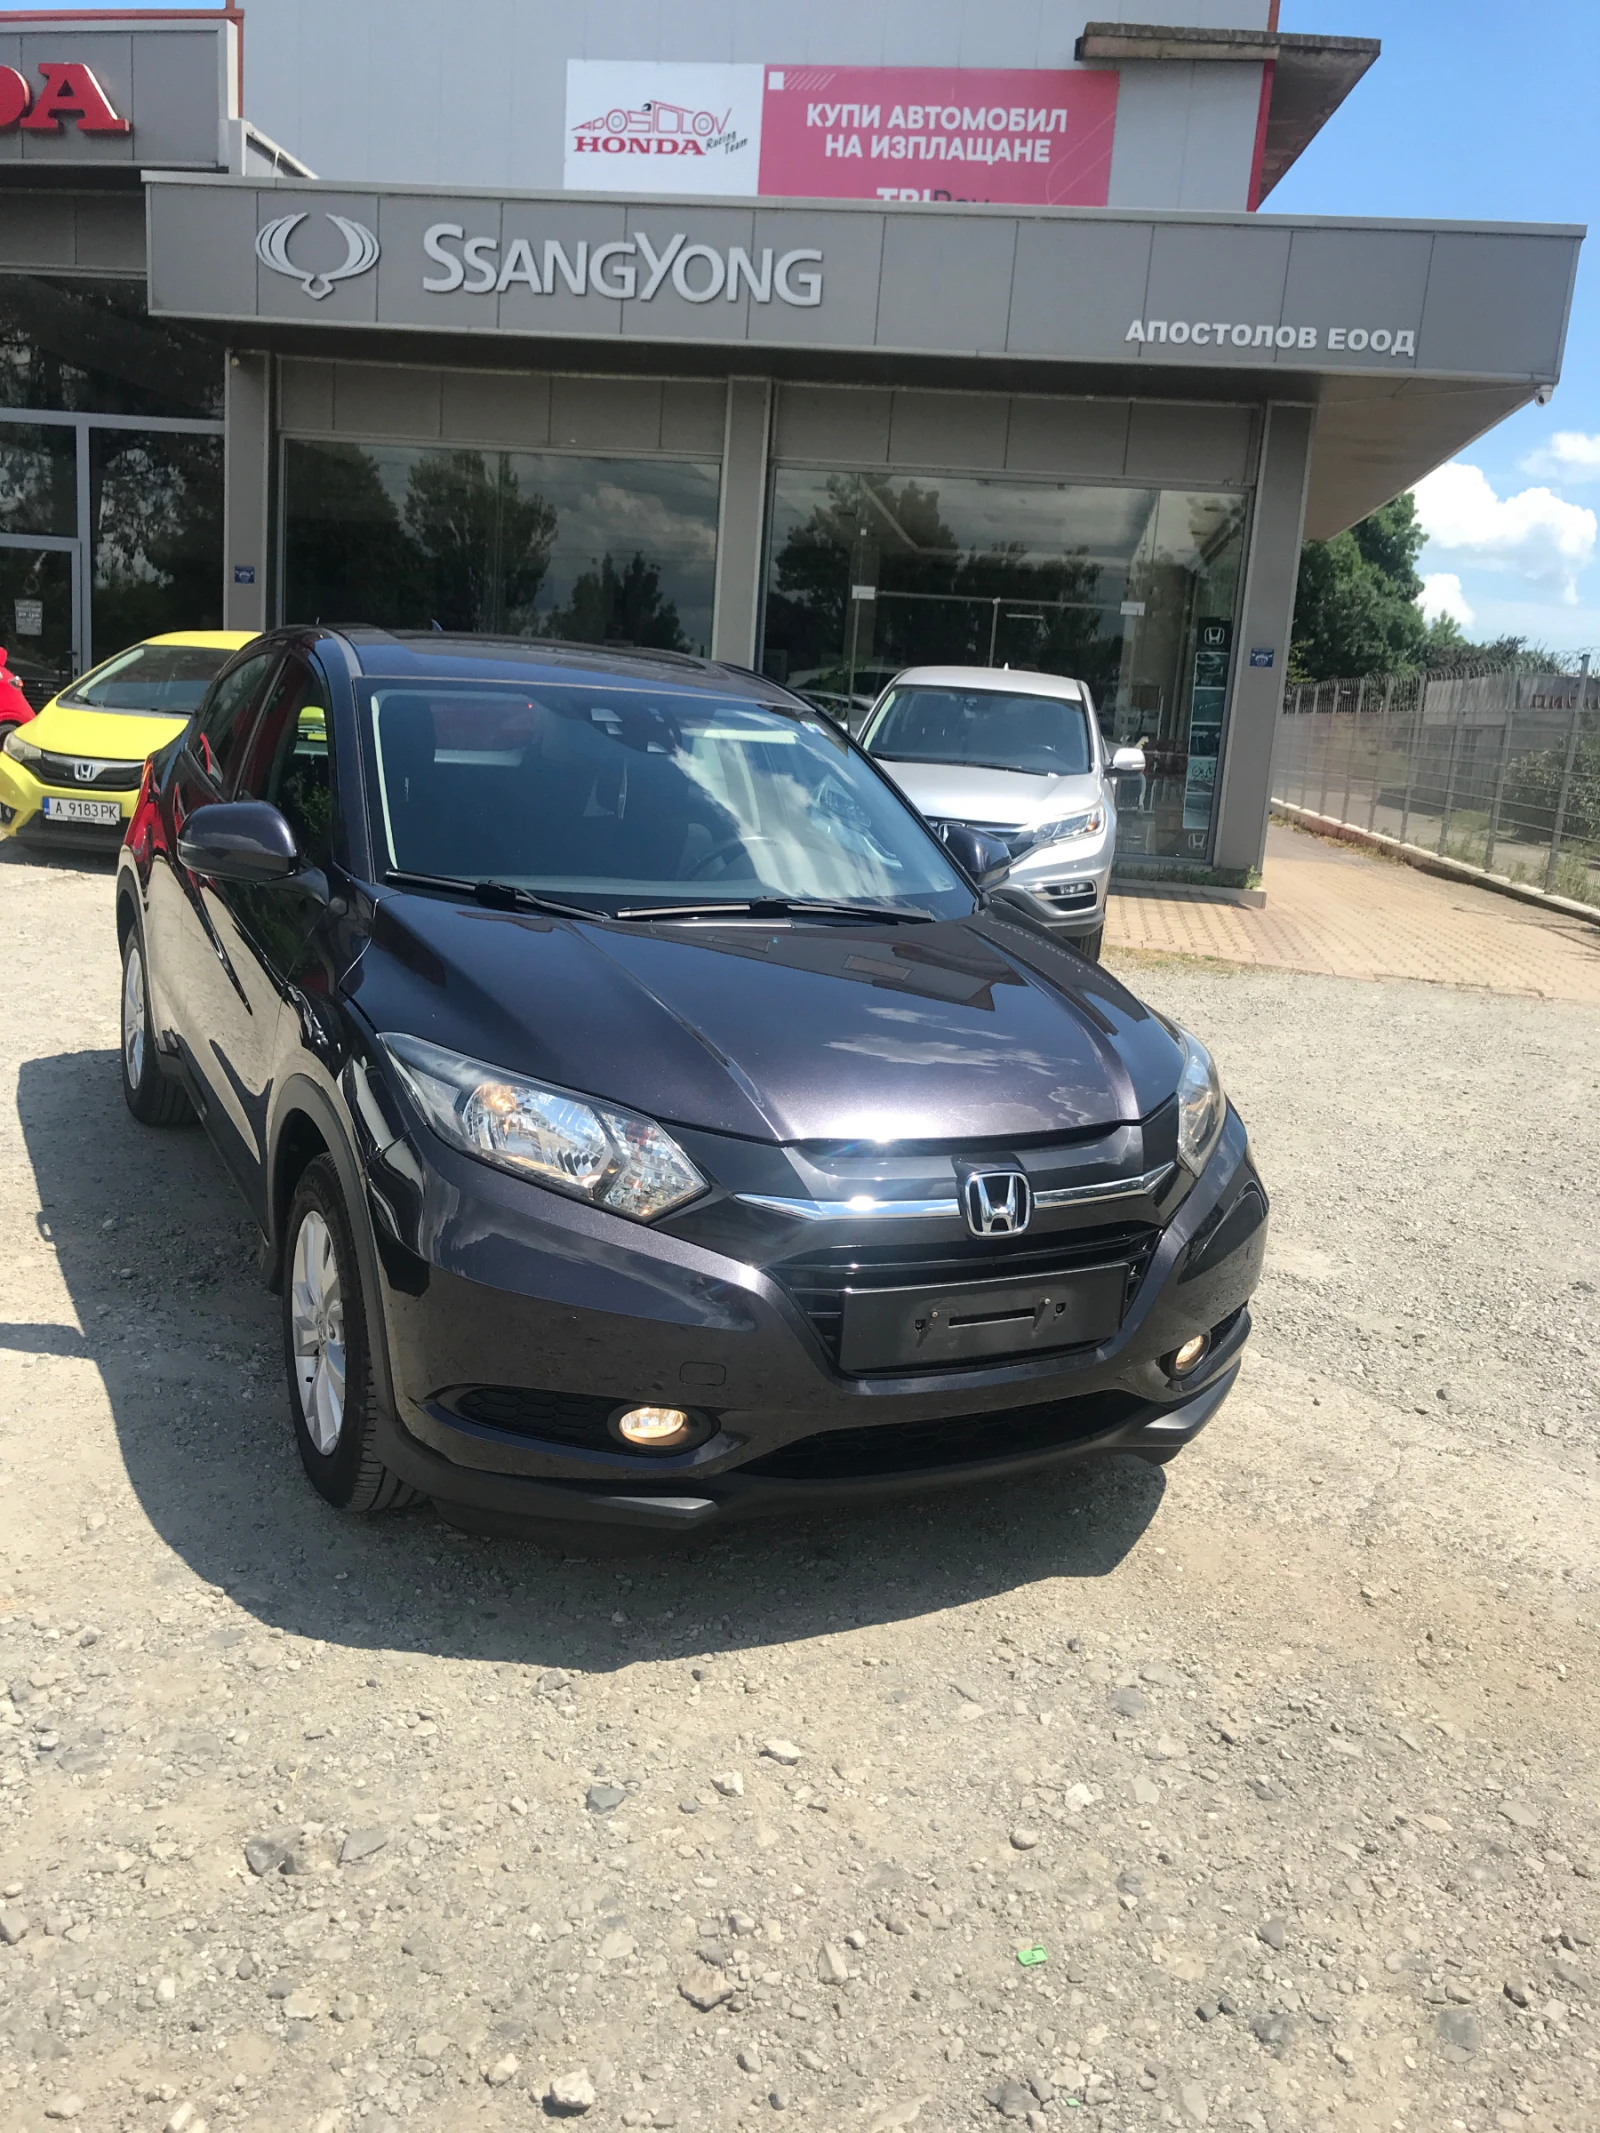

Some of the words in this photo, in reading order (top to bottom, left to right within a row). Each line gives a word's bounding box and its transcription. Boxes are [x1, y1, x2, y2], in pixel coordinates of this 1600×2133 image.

[806, 103, 881, 129] КУПИ
[887, 105, 1068, 133] АВТОМОБИЛ
[573, 136, 706, 156] HONDA
[705, 131, 737, 151] Racing
[725, 138, 748, 155] Team
[825, 134, 863, 158] НА
[870, 135, 1051, 165] ИЗПЛАЩАНЕ
[1124, 319, 1318, 349] АПОСТОЛОВ
[1326, 327, 1416, 357] ЕООД
